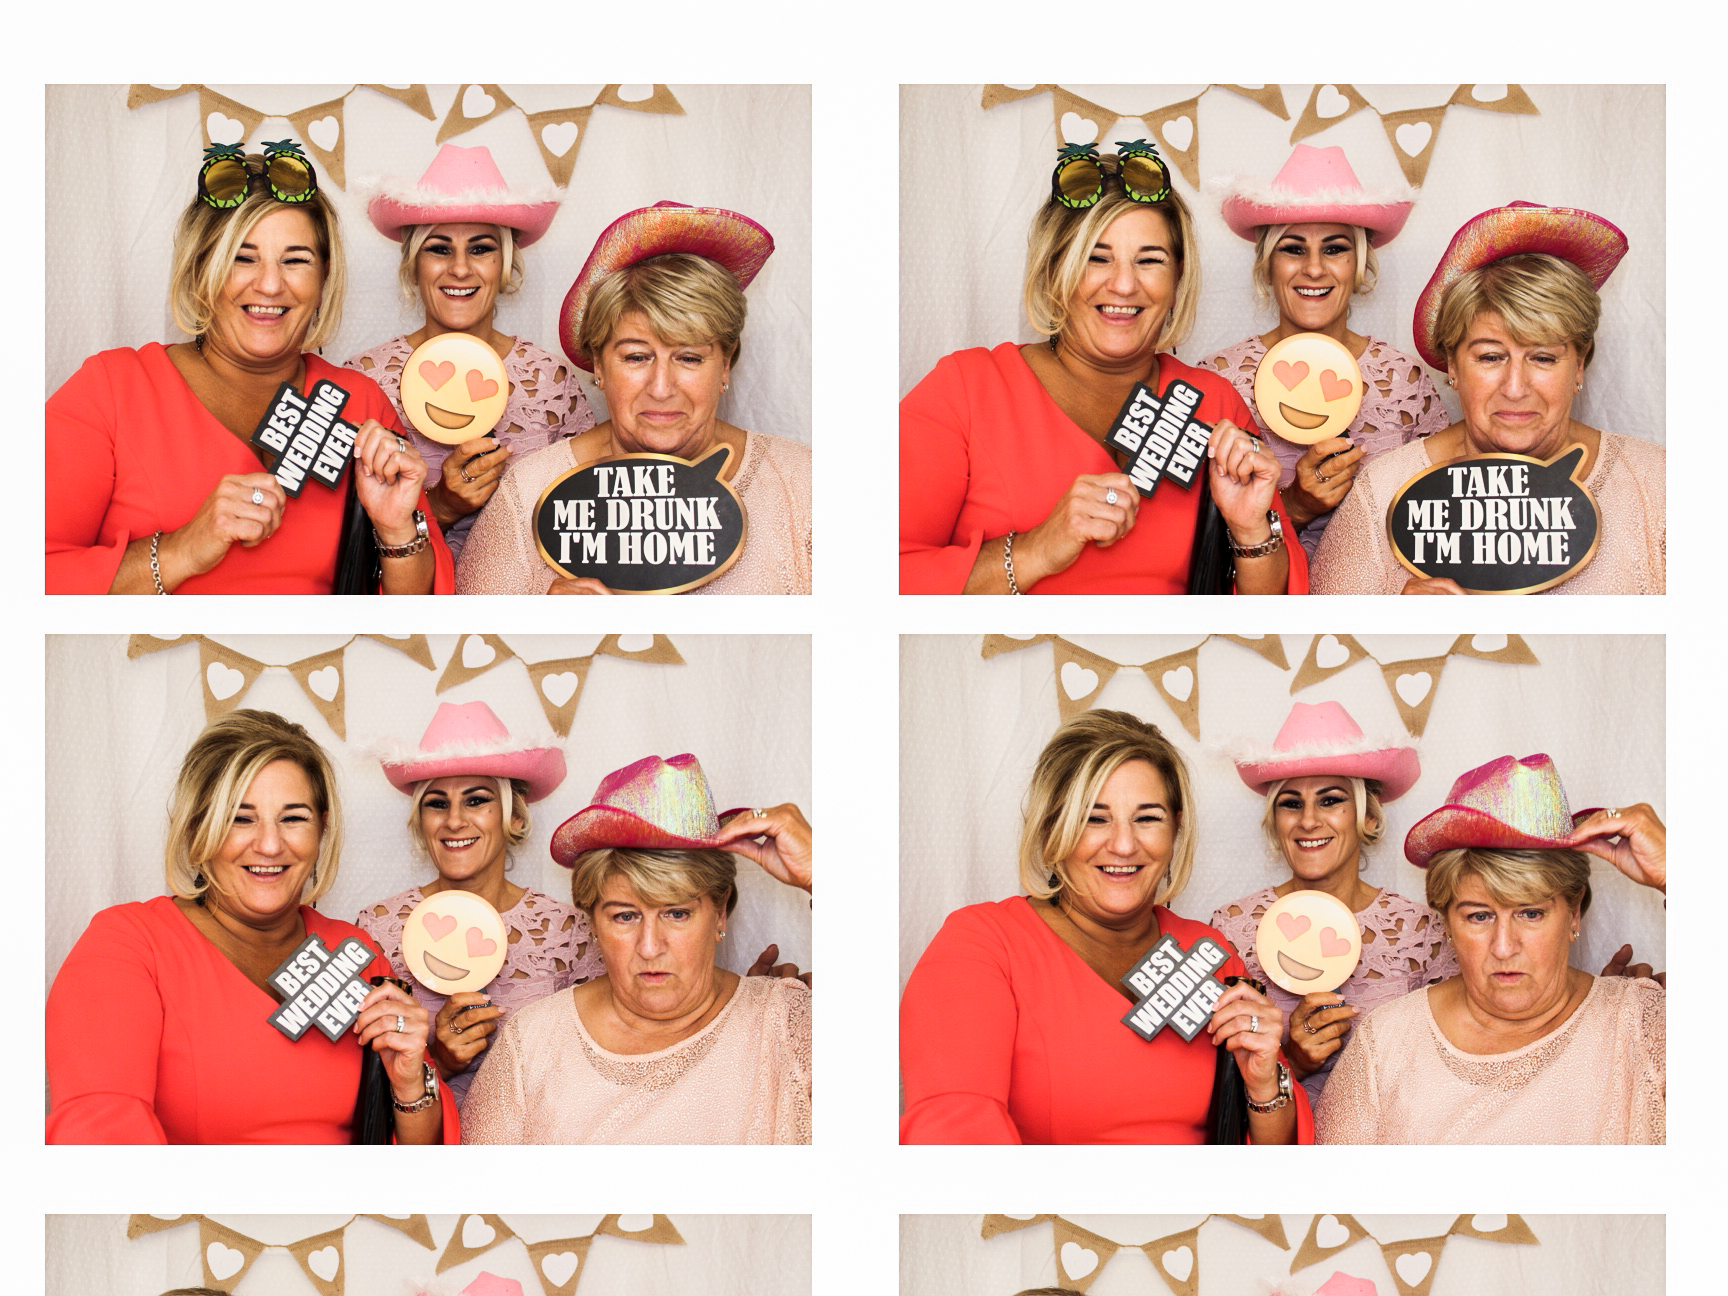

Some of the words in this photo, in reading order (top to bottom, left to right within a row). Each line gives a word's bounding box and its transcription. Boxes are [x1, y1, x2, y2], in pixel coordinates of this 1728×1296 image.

[259, 387, 308, 453] BEST
[275, 383, 345, 492] WEDDING
[1113, 387, 1162, 453] BEST
[1129, 383, 1199, 492] WEDDING
[312, 422, 358, 483] EVER
[593, 464, 676, 498] TAKE
[1166, 422, 1212, 483] EVER
[1447, 464, 1530, 498] TAKE
[552, 499, 596, 531] ME
[605, 496, 723, 531] DRUNK
[1406, 499, 1450, 531] ME
[1459, 496, 1577, 531] DRUNK
[558, 531, 608, 564] I'M
[617, 531, 717, 565] HOME
[1412, 531, 1462, 564] I'M
[1471, 531, 1571, 565] HOME
[274, 939, 330, 997] BEST
[275, 941, 371, 1036] WEDDING
[1128, 939, 1184, 997] BEST
[1129, 941, 1225, 1036] WEDDING
[316, 979, 371, 1036] EVER
[1170, 979, 1225, 1036] EVER
